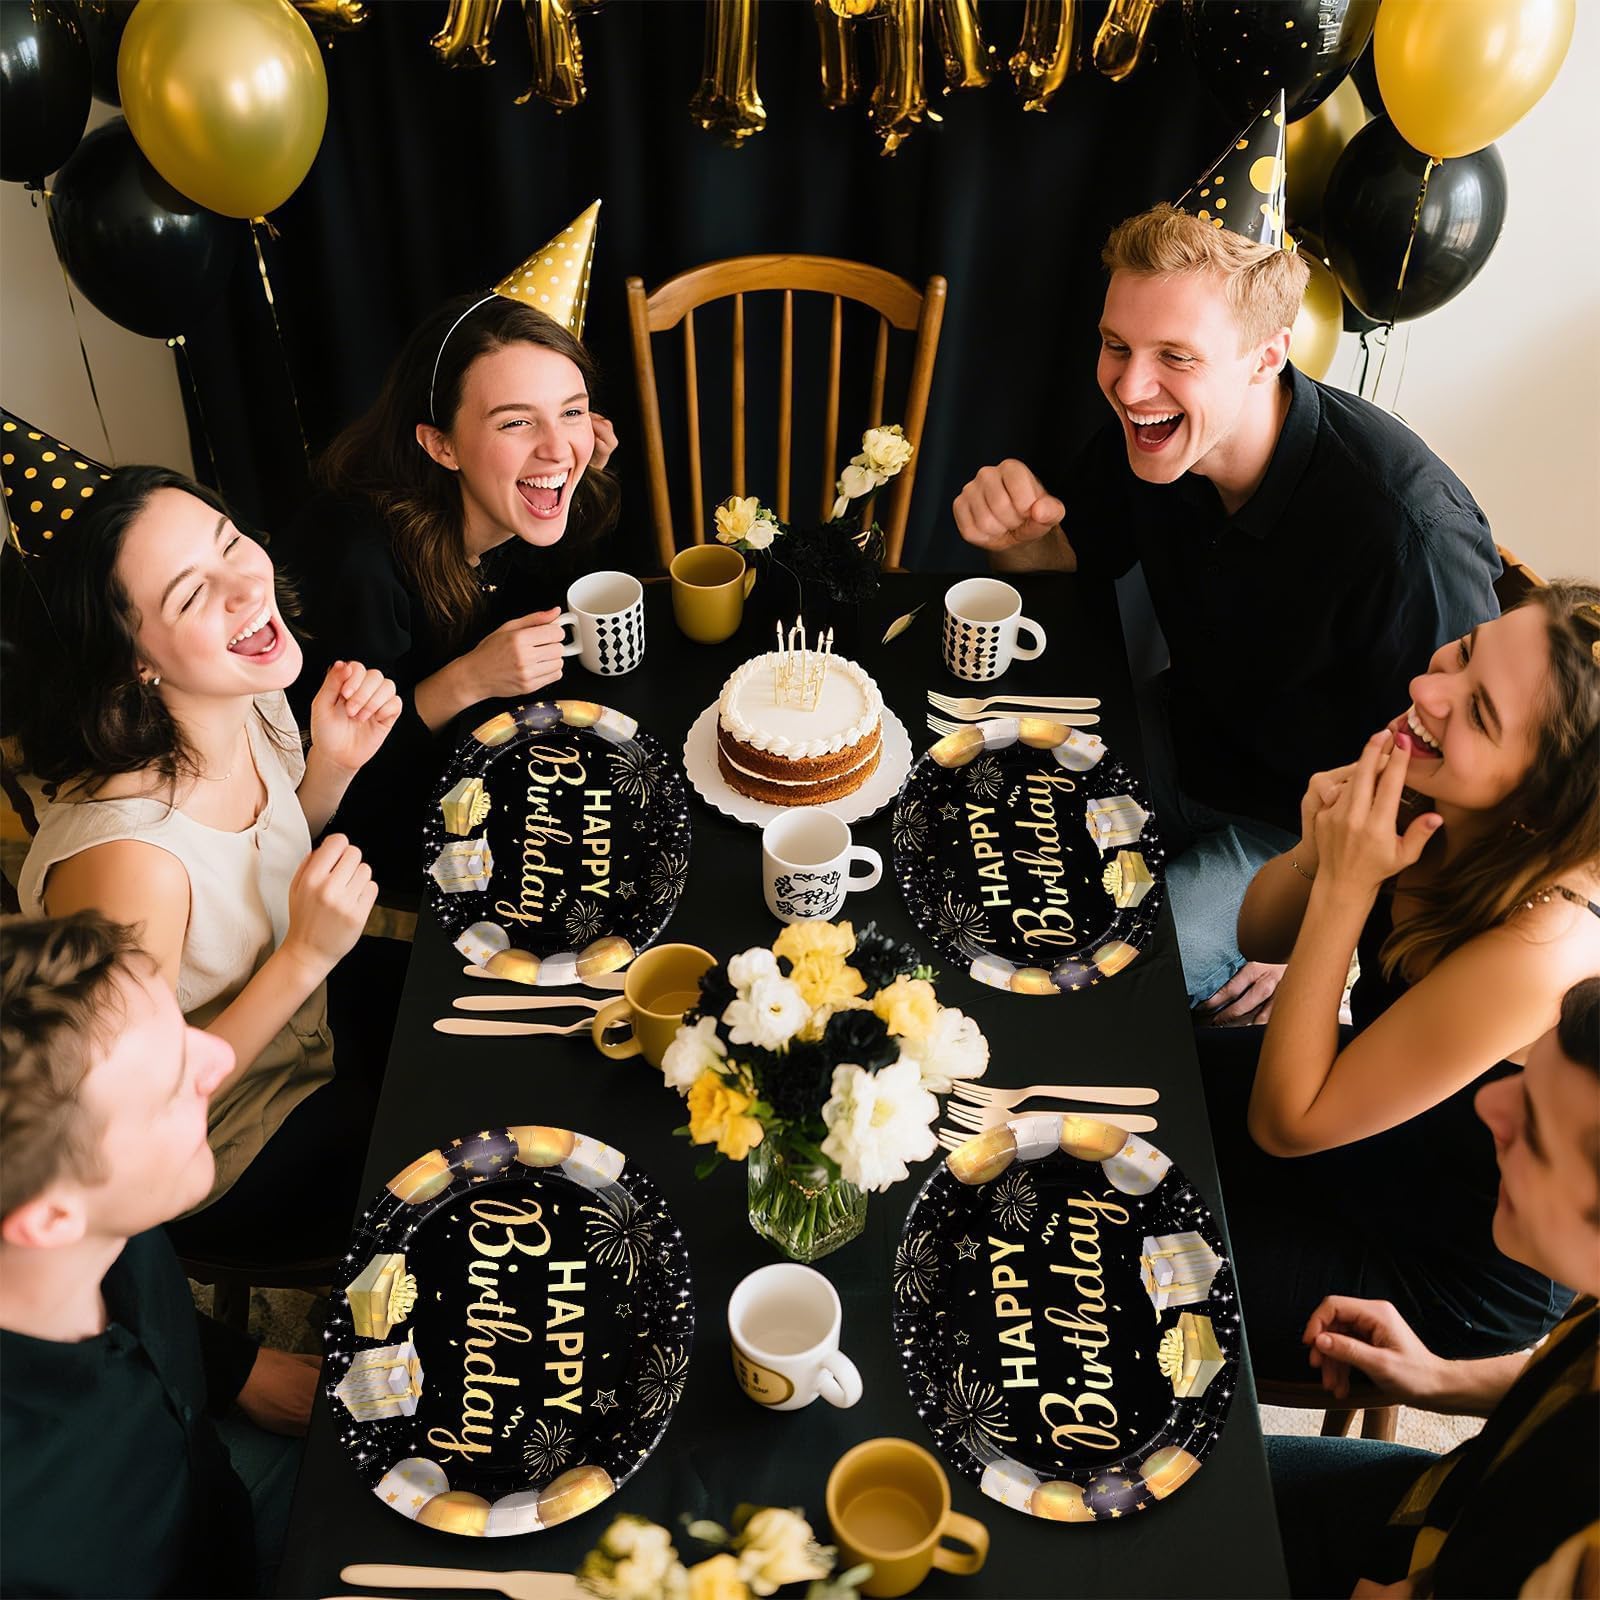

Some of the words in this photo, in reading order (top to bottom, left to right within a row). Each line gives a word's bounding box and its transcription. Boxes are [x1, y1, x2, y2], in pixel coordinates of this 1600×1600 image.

[495, 745, 587, 928] Birthday
[581, 790, 612, 898] HAPPY
[965, 802, 1011, 907] HAPPY
[1012, 768, 1077, 947] Birthday
[427, 1198, 552, 1462] Birthday
[543, 1260, 587, 1415] HAPPY
[987, 1235, 1040, 1389] HAPPY
[1039, 1190, 1130, 1451] Birthday
